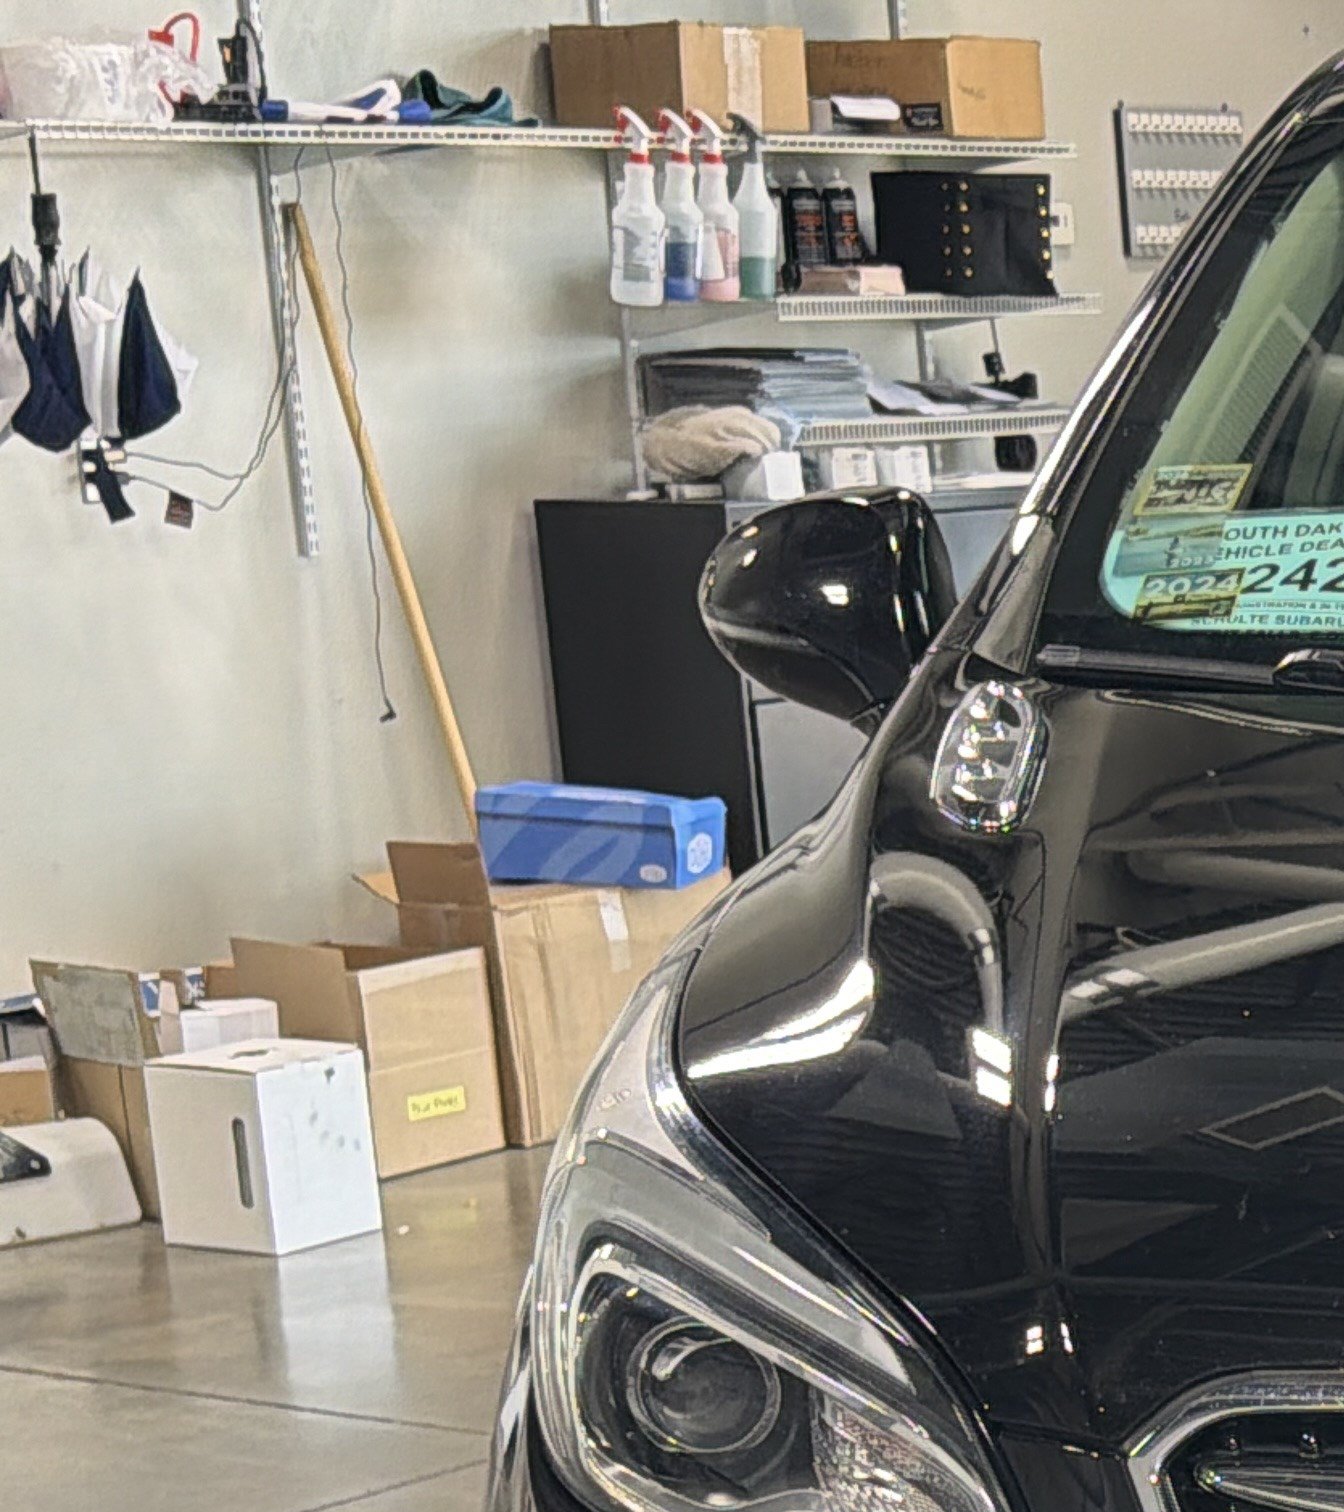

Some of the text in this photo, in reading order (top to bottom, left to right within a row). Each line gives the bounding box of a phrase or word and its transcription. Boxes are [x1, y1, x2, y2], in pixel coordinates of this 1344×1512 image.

[1224, 524, 1289, 541] OUTH
[1215, 543, 1293, 561] EHICLE
[1144, 574, 1239, 598] 2024
